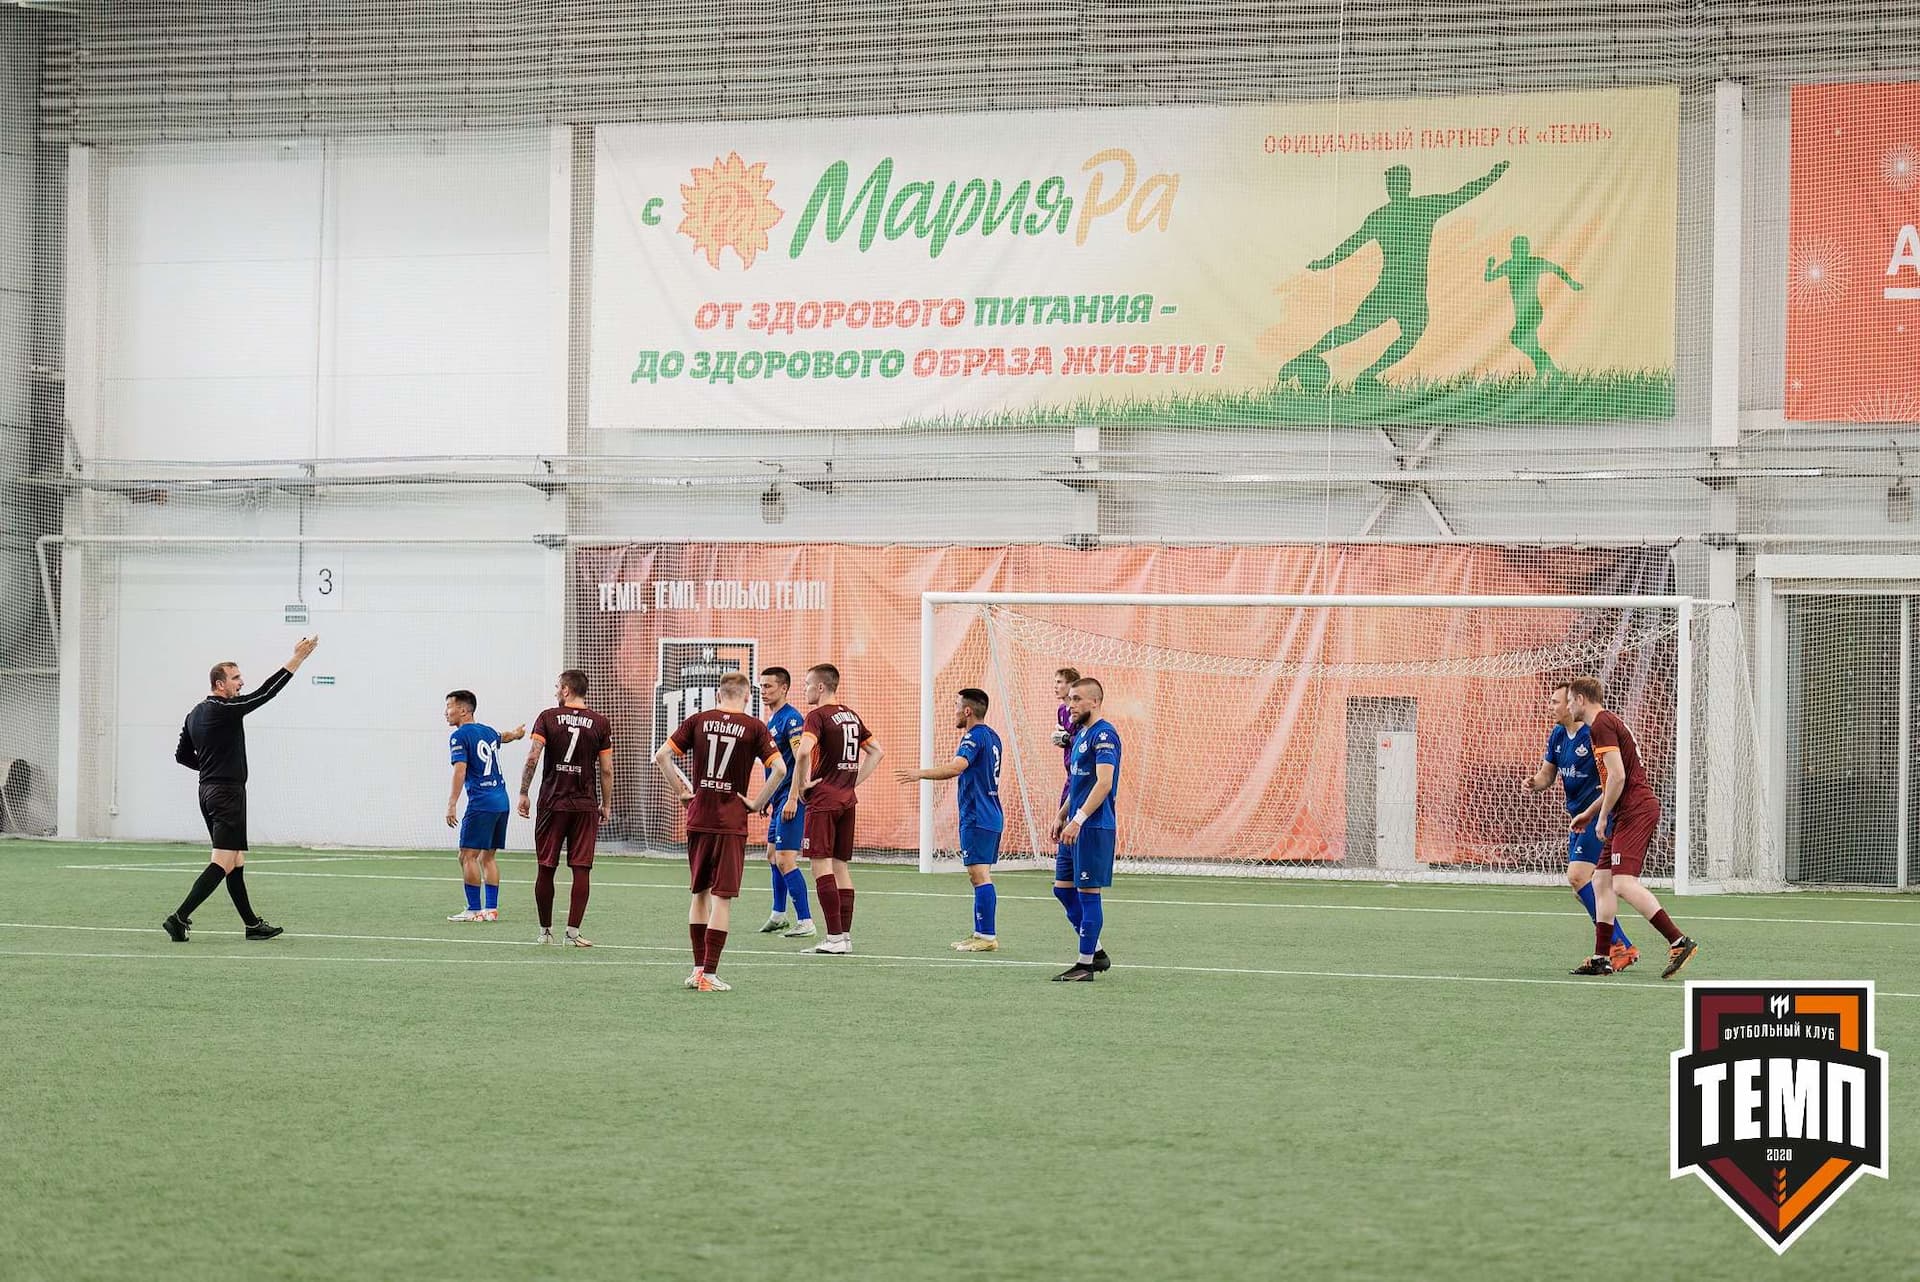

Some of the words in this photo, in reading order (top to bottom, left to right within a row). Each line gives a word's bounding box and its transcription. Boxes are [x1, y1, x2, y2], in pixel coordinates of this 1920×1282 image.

[1264, 126, 1413, 158] ОФИЦИАЛЬНЫЙ
[1421, 125, 1501, 150] ПАРТНЕР
[1507, 125, 1530, 146] СК
[1536, 121, 1614, 146] «ТЕМП»
[694, 301, 743, 330] ОТ
[747, 298, 966, 336] ЗДОРОВОГО
[974, 293, 1154, 326] ПИТАНИЯ
[630, 350, 683, 384] ДО
[688, 349, 905, 385] ЗДОРОВОГО
[912, 345, 1054, 378] ОБРАЗА
[318, 568, 333, 595] 3
[598, 582, 647, 613] ТЕМП,
[652, 580, 699, 611] ТЕМП,
[705, 579, 770, 610] ТОЛЬКО
[775, 580, 826, 610] ТЕМП!
[564, 726, 580, 763] 7
[703, 720, 746, 737] КУЗЬКИН
[842, 723, 859, 761] 15
[707, 734, 737, 779] 17
[700, 779, 732, 790] SEUS
